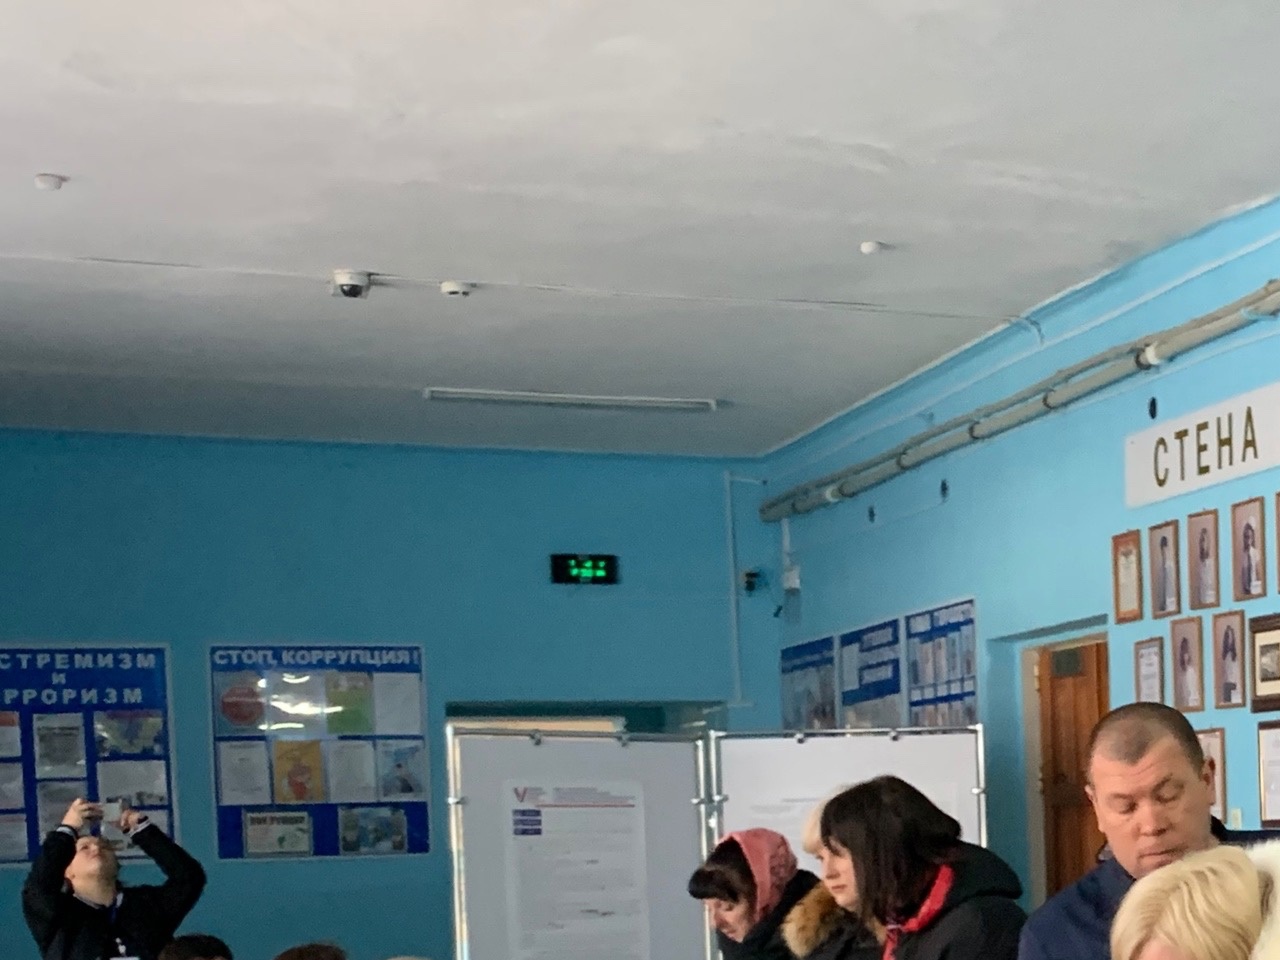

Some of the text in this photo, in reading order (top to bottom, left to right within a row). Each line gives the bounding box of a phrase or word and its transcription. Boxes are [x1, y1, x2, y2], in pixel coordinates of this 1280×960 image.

[1153, 405, 1259, 488] СТЕНА
[0, 652, 156, 669] СТРЕМИЗМ
[3, 688, 143, 705] РРОРИЗМ
